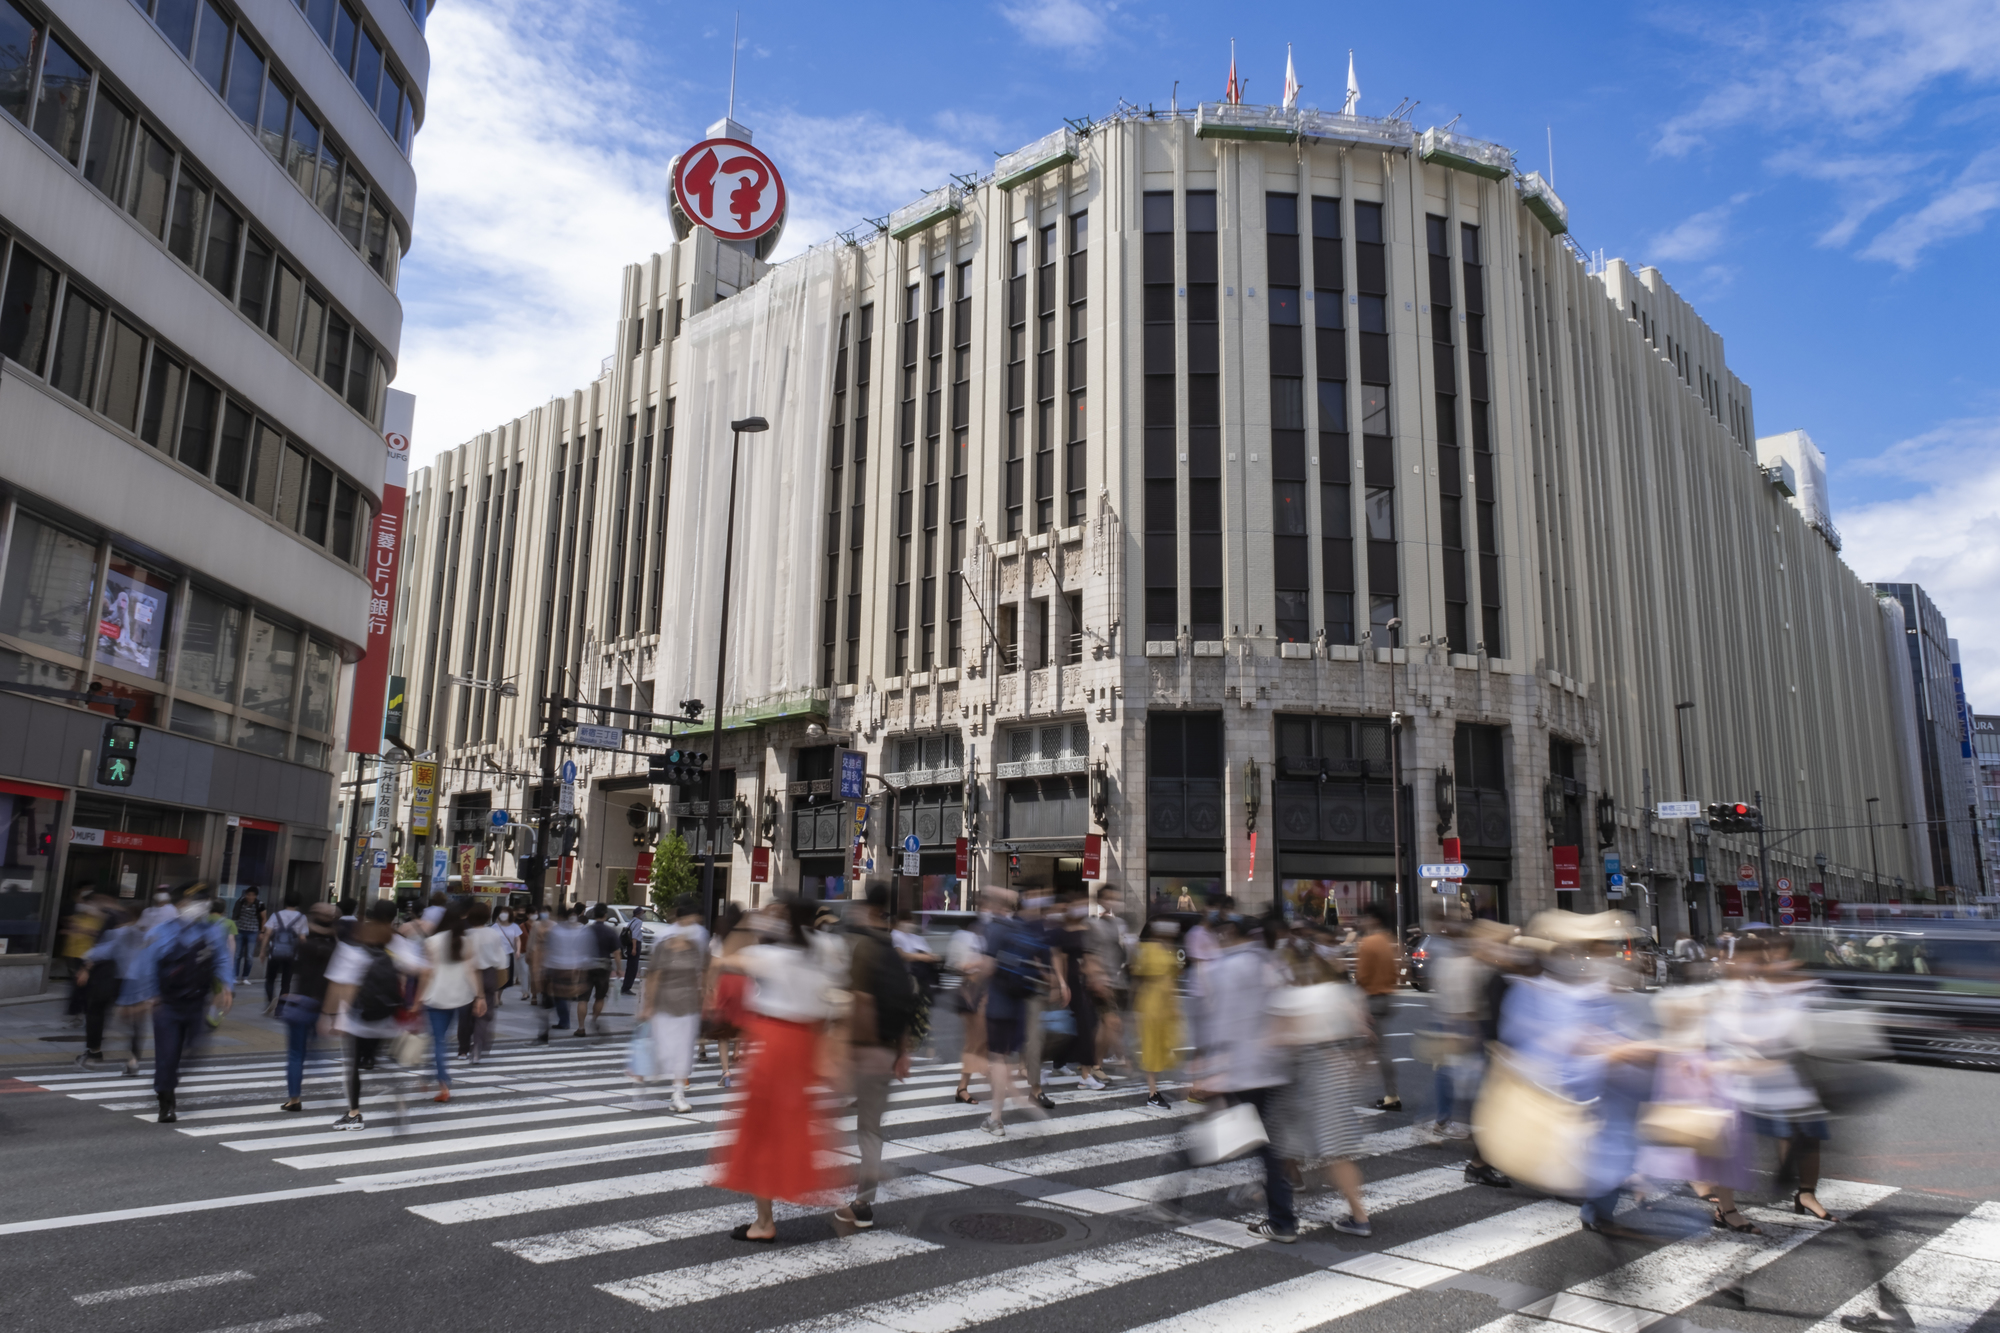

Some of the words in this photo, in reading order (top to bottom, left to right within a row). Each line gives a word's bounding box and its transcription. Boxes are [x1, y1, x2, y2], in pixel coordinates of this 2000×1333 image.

[368, 512, 398, 634] 三菱UFJ銀行
[581, 727, 618, 740] 新宿三丁目
[418, 766, 432, 784] 薬
[76, 831, 96, 841] MUFG
[435, 860, 446, 877] 7
